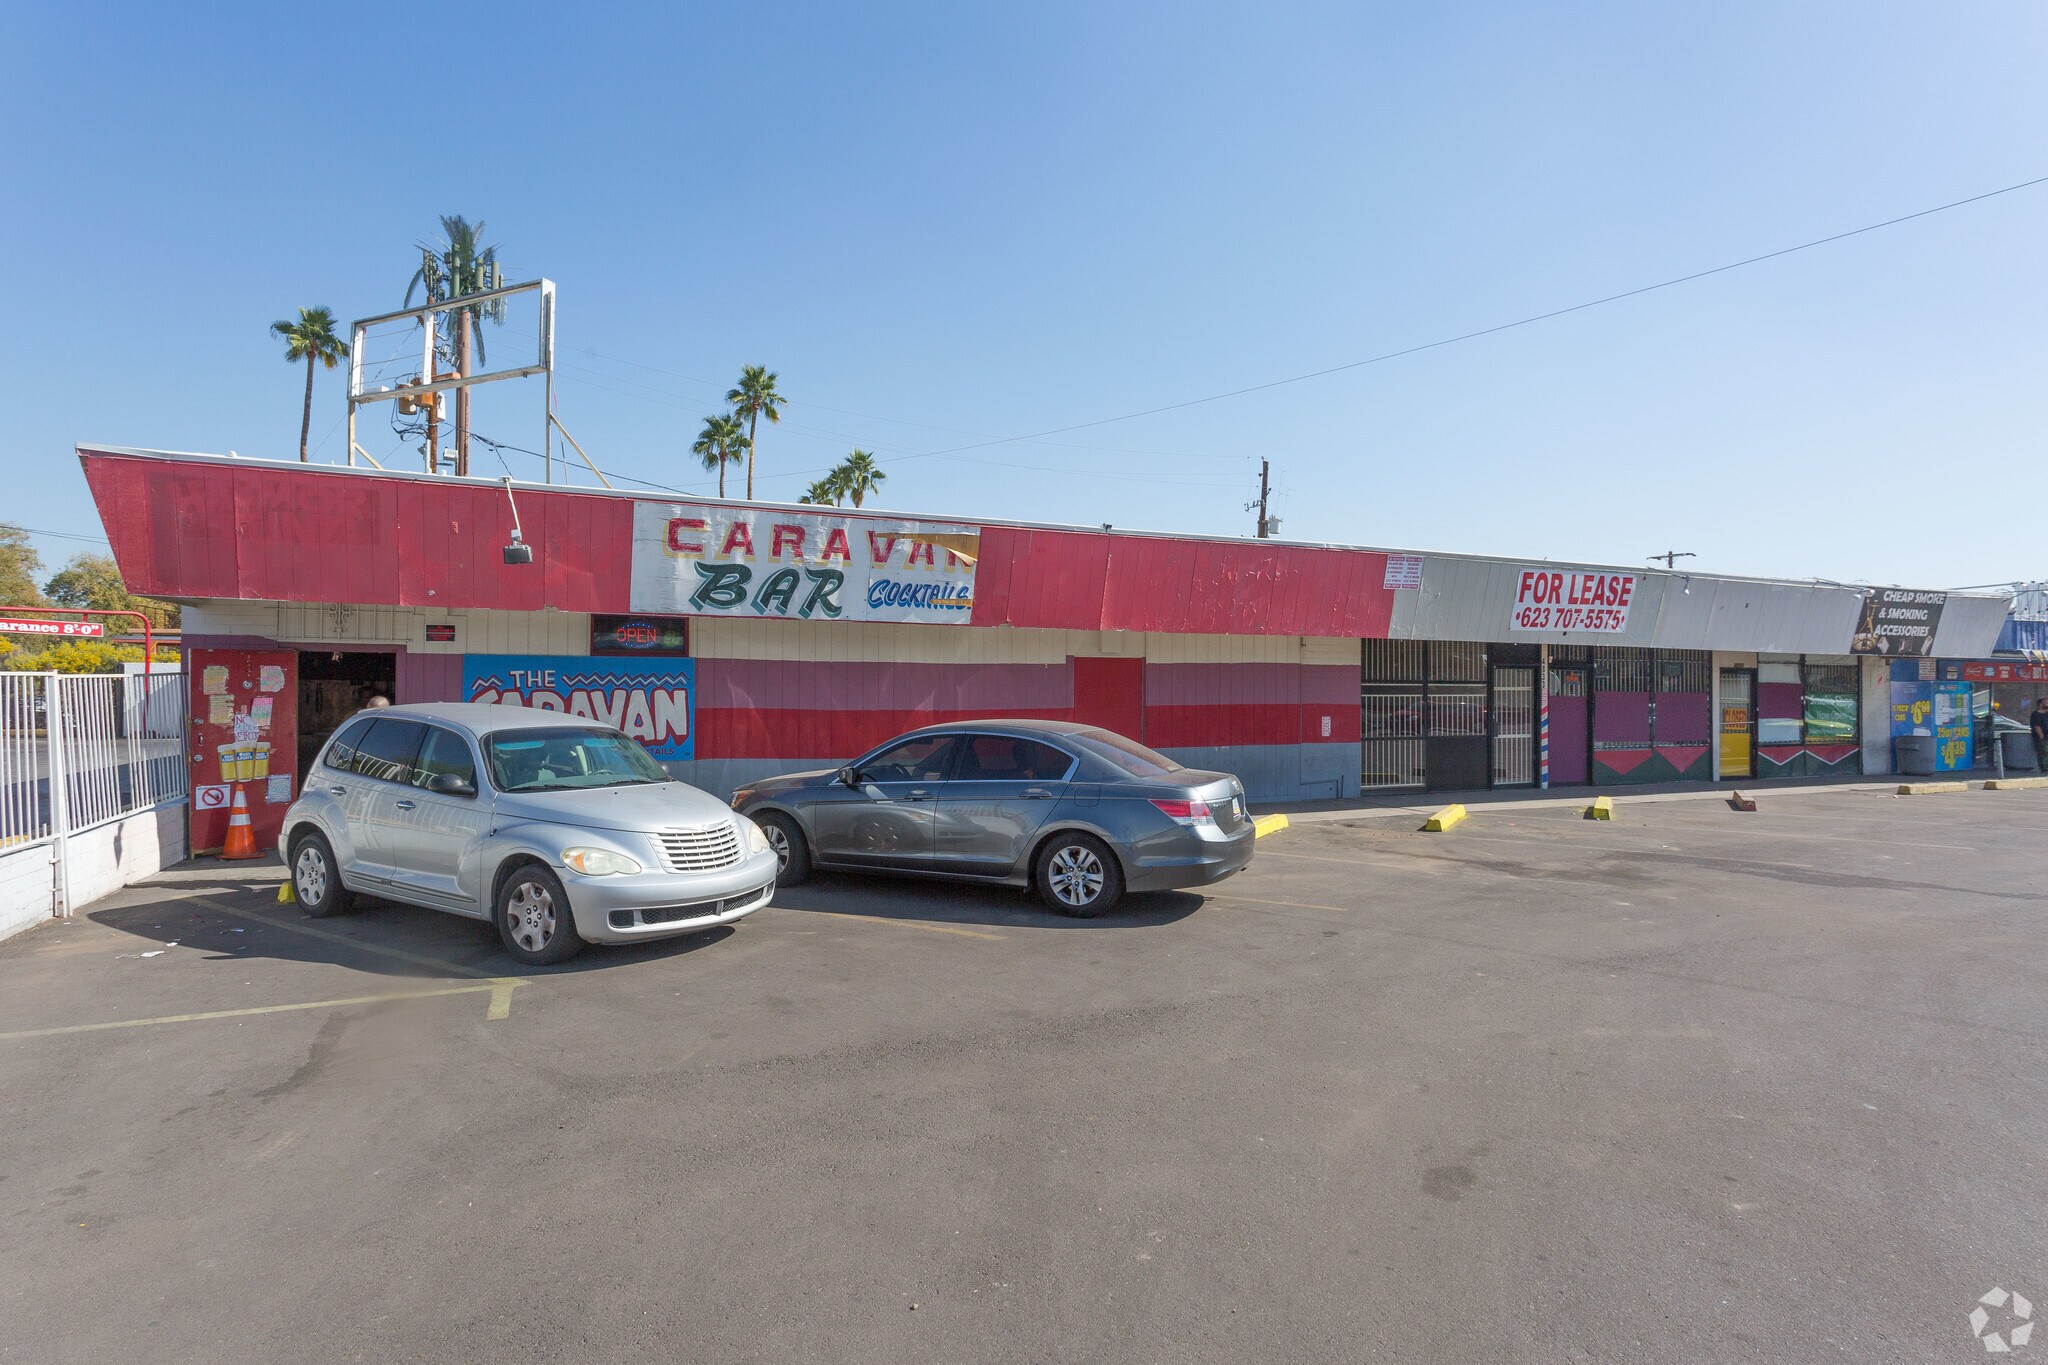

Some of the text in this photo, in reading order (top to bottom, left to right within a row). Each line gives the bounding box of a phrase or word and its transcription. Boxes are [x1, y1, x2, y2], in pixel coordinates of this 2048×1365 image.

[688, 560, 845, 620] BAR
[1519, 571, 1634, 607] FOR LEASE
[1884, 590, 1946, 605] CHEAP SMOKE
[1520, 606, 1623, 630] 623 707-5575
[1878, 607, 1928, 621] & SMOKING
[0, 622, 59, 633] arance
[1873, 624, 1930, 637] ACCESSORIES
[616, 628, 657, 643] OPEN
[510, 670, 556, 689] THE
[645, 747, 674, 755] TAILS
